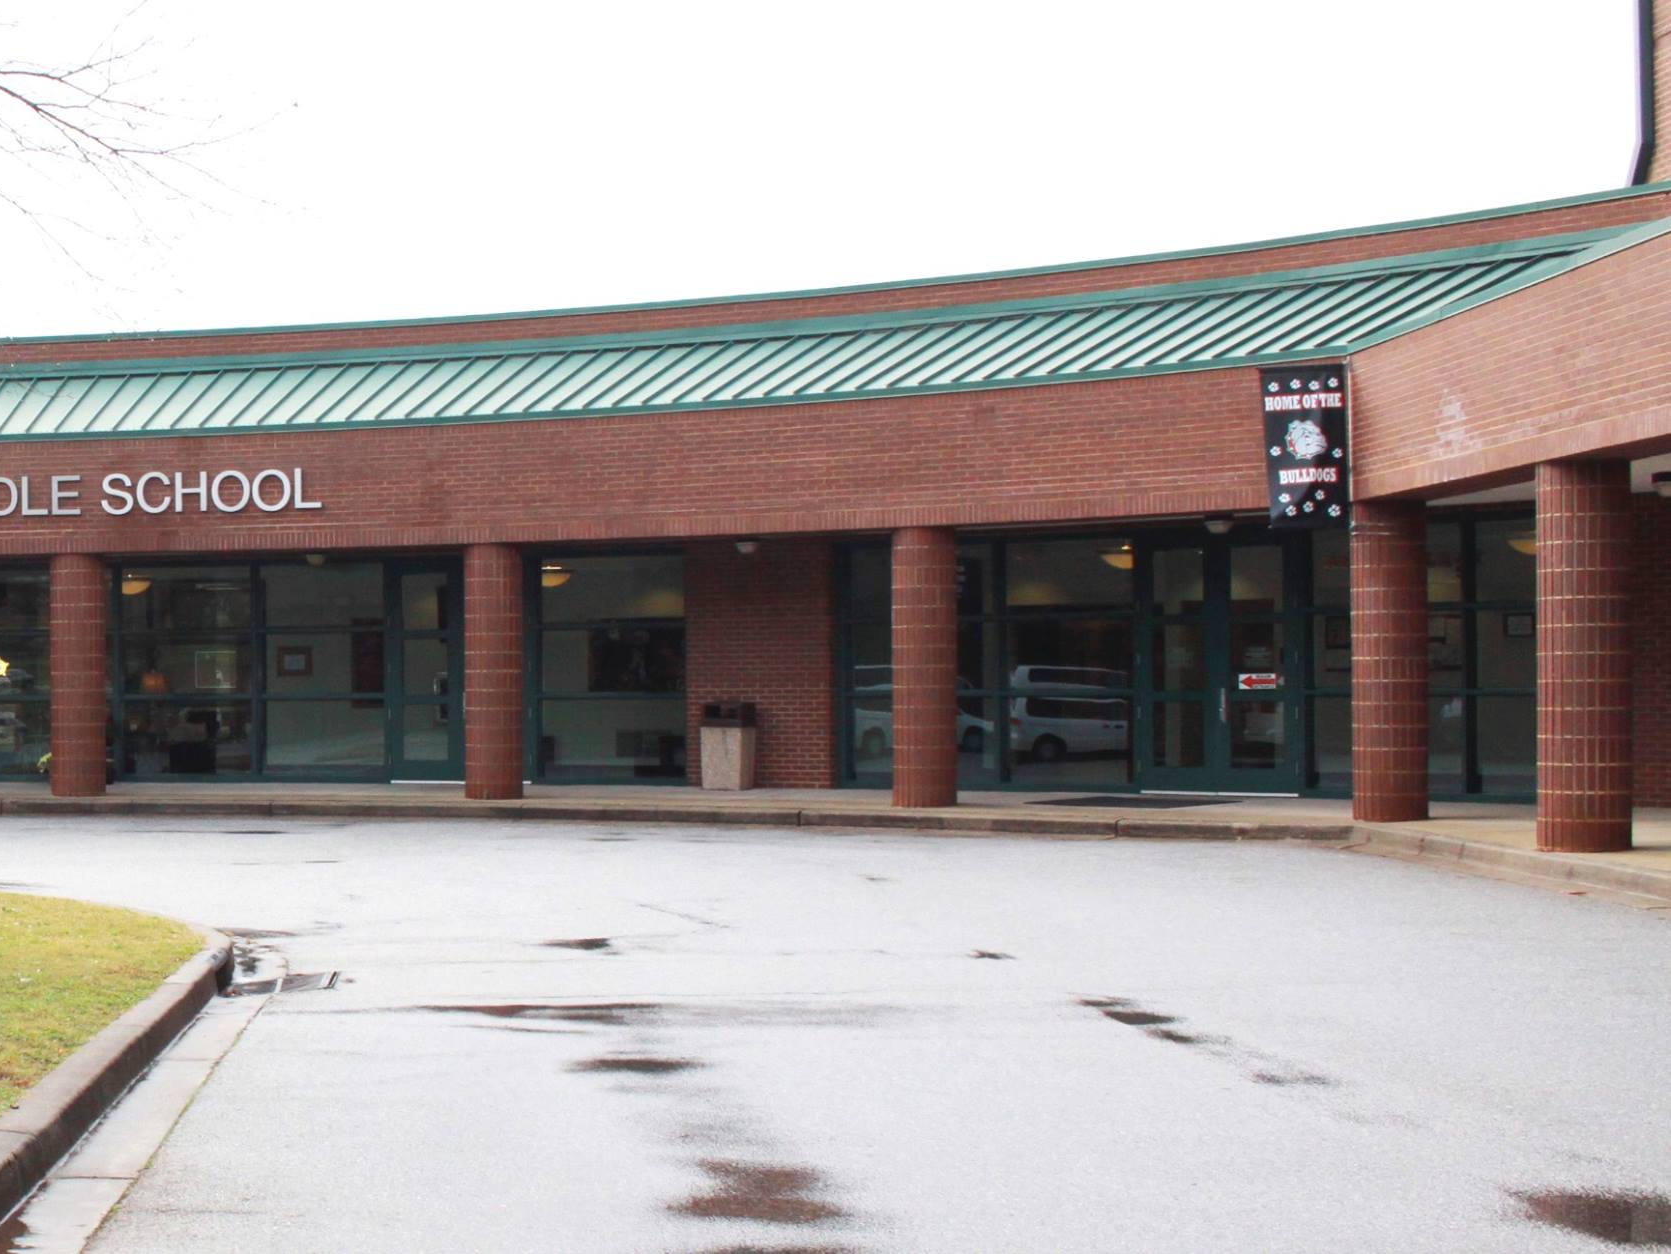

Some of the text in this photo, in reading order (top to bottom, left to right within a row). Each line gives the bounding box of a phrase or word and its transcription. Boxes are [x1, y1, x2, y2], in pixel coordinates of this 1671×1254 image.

[1265, 393, 1342, 412] HOME OF THE
[1278, 467, 1338, 484] BULLDOGS
[100, 467, 323, 515] SCHOOL
